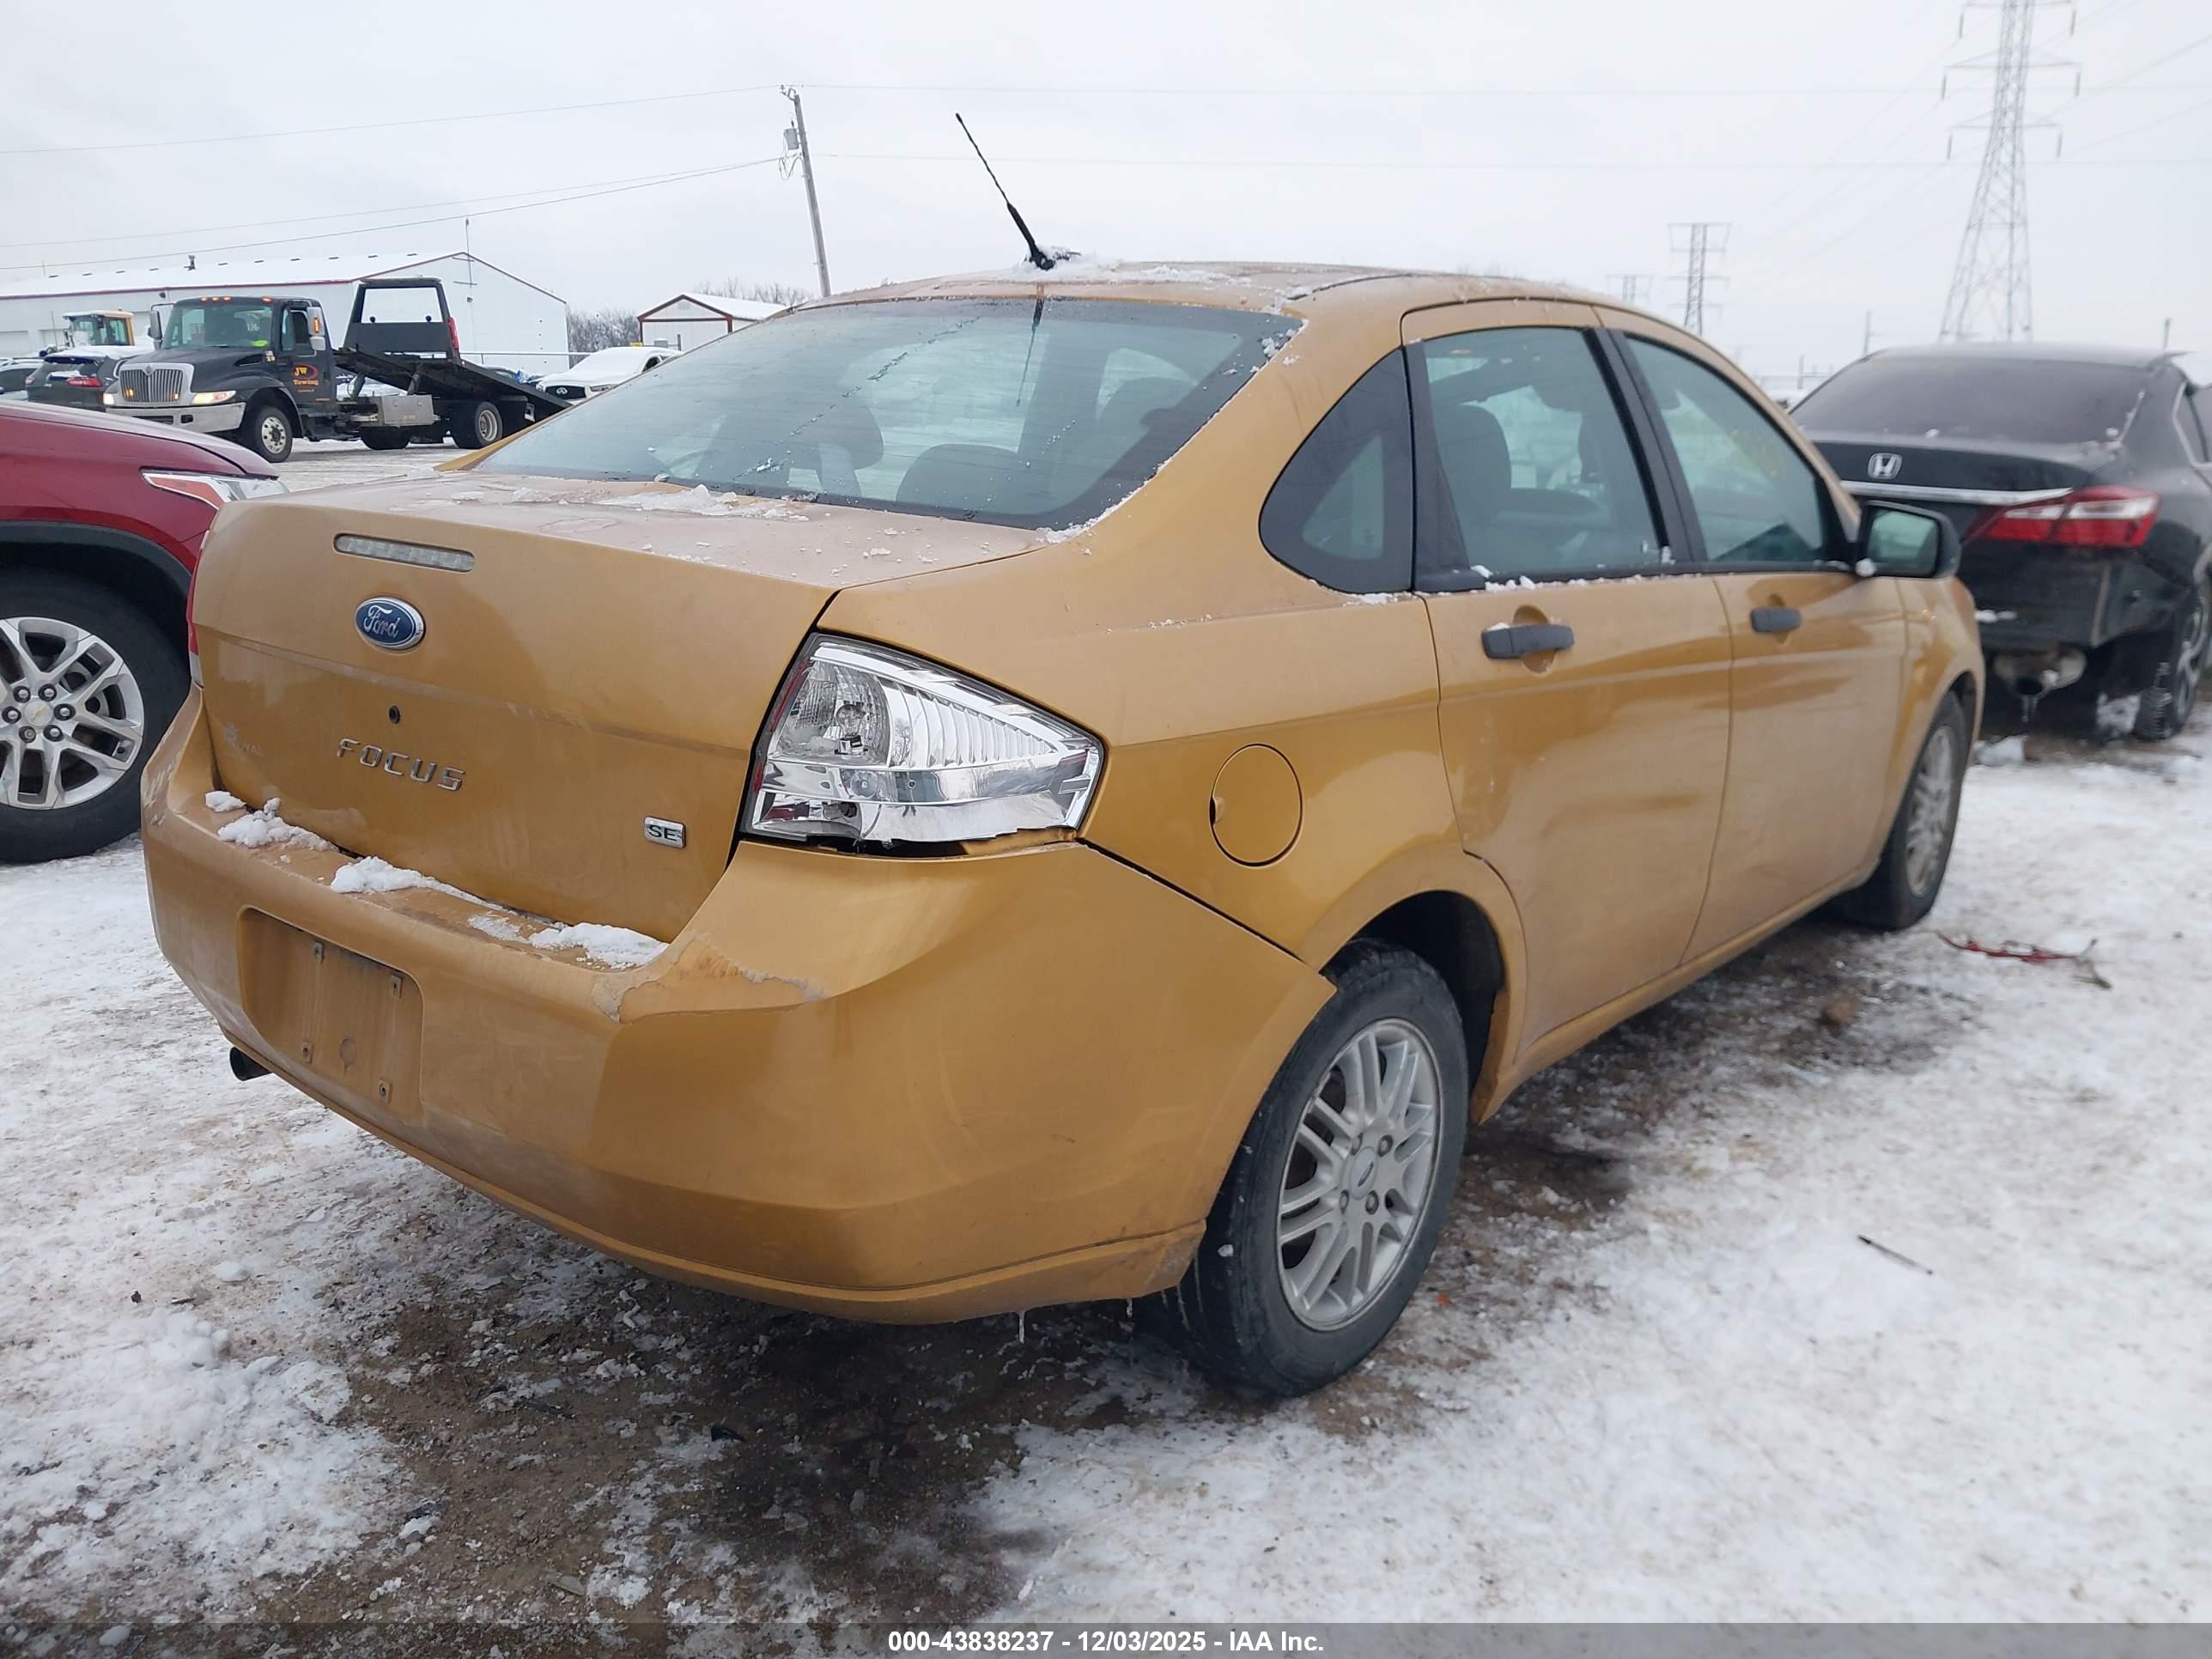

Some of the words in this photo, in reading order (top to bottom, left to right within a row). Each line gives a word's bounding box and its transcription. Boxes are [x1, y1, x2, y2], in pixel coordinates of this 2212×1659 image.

[363, 605, 401, 638] Ford
[336, 738, 466, 791] FOCUS
[648, 824, 678, 842] SE
